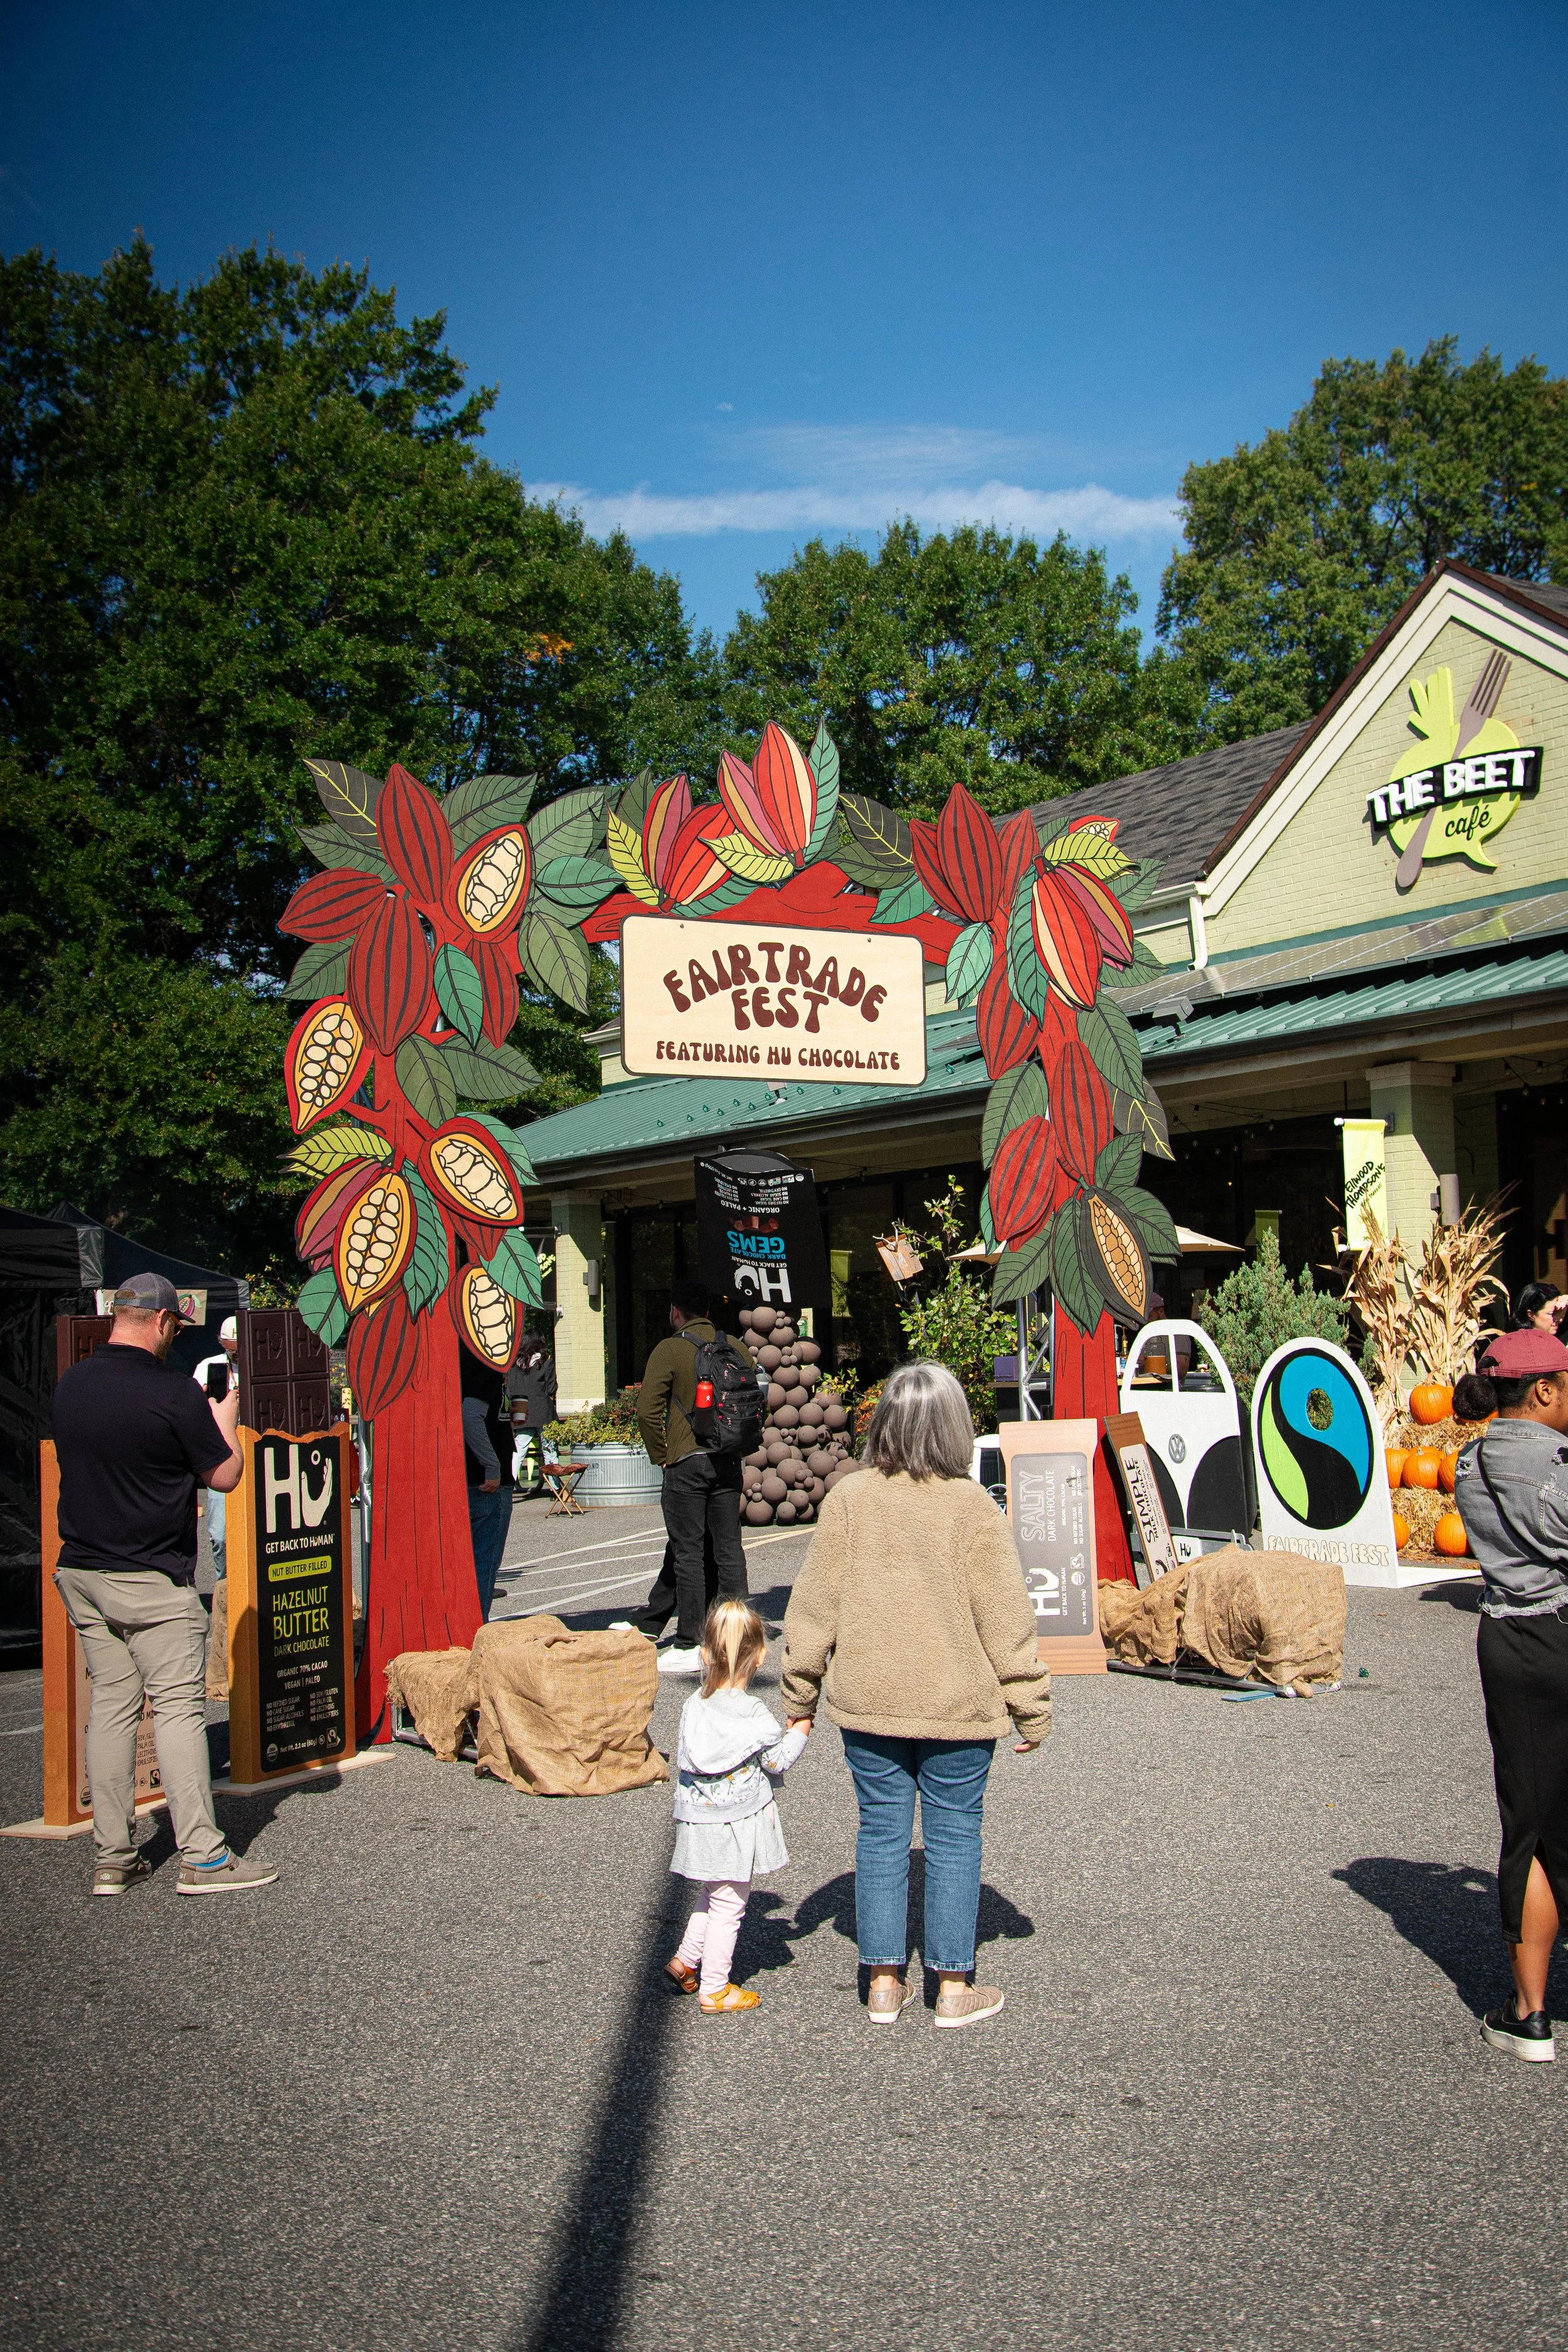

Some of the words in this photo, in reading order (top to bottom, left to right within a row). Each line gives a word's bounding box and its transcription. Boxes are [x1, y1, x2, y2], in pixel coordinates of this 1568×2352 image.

[1366, 770, 1435, 823] THE
[1444, 750, 1535, 798] BEET
[1445, 804, 1491, 841] café
[664, 942, 887, 1022] FAIRTRADE
[731, 987, 829, 1034] FEST
[656, 1041, 760, 1064] FEATURING
[767, 1046, 791, 1066] HU
[798, 1047, 900, 1071] CHOCOLATE
[721, 1200, 741, 1210] PALEO
[727, 1231, 785, 1254] GEMS
[730, 1247, 765, 1259] CHOCOLATE
[1046, 1470, 1056, 1517] CHOCOLATE
[1134, 1459, 1152, 1512] CHOCOLATE
[1019, 1470, 1046, 1542] SALTY
[1125, 1458, 1156, 1543] SIMPLE
[1047, 1518, 1056, 1541] DARK
[1150, 1515, 1158, 1539] MILK
[266, 1542, 279, 1554] GET
[280, 1539, 299, 1552] BACK
[300, 1537, 309, 1549] TO
[1351, 1542, 1389, 1566] FEST
[272, 1567, 284, 1577] NUT
[285, 1564, 307, 1575] BUTTER
[309, 1560, 327, 1571] FILLED
[273, 1586, 328, 1612] HAZELNUT
[273, 1608, 329, 1640] BUTTER
[274, 1643, 292, 1657] DARK
[293, 1636, 330, 1653] CHOCOLATE
[277, 1666, 299, 1678] ORGANIC
[300, 1664, 311, 1673] 70%
[311, 1660, 328, 1671] CACAO
[284, 1679, 300, 1690] VEGAN
[305, 1675, 320, 1685] PALEO
[283, 1704, 295, 1713] SUGAR
[288, 1696, 300, 1704] SUGAR
[316, 1697, 326, 1705] PALM
